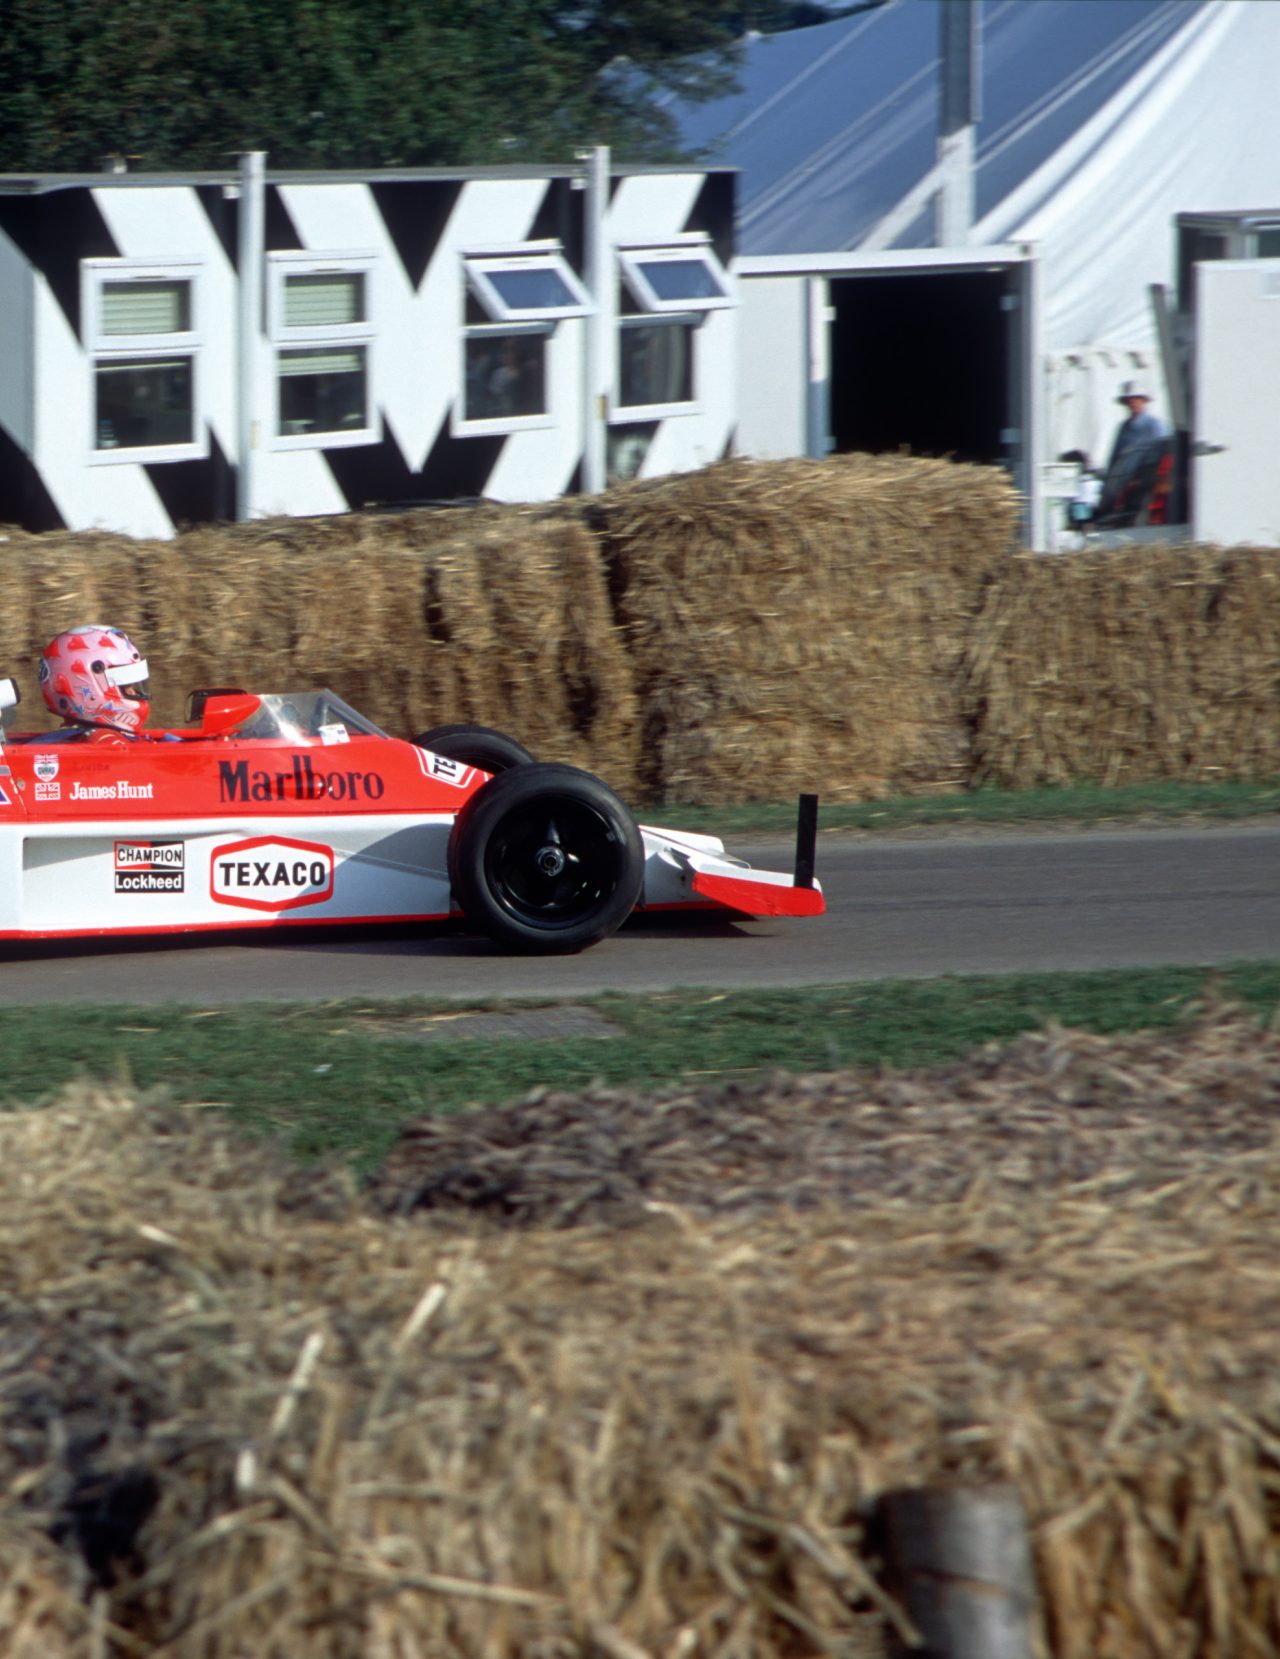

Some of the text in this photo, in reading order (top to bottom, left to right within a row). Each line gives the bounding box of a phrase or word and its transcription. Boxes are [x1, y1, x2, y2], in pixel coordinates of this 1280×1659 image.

[218, 755, 385, 803] Marlboro
[69, 781, 154, 800] James Hunt
[117, 848, 182, 862] CHAMPION
[115, 874, 182, 889] Lockheed
[219, 862, 325, 886] TEXACO
